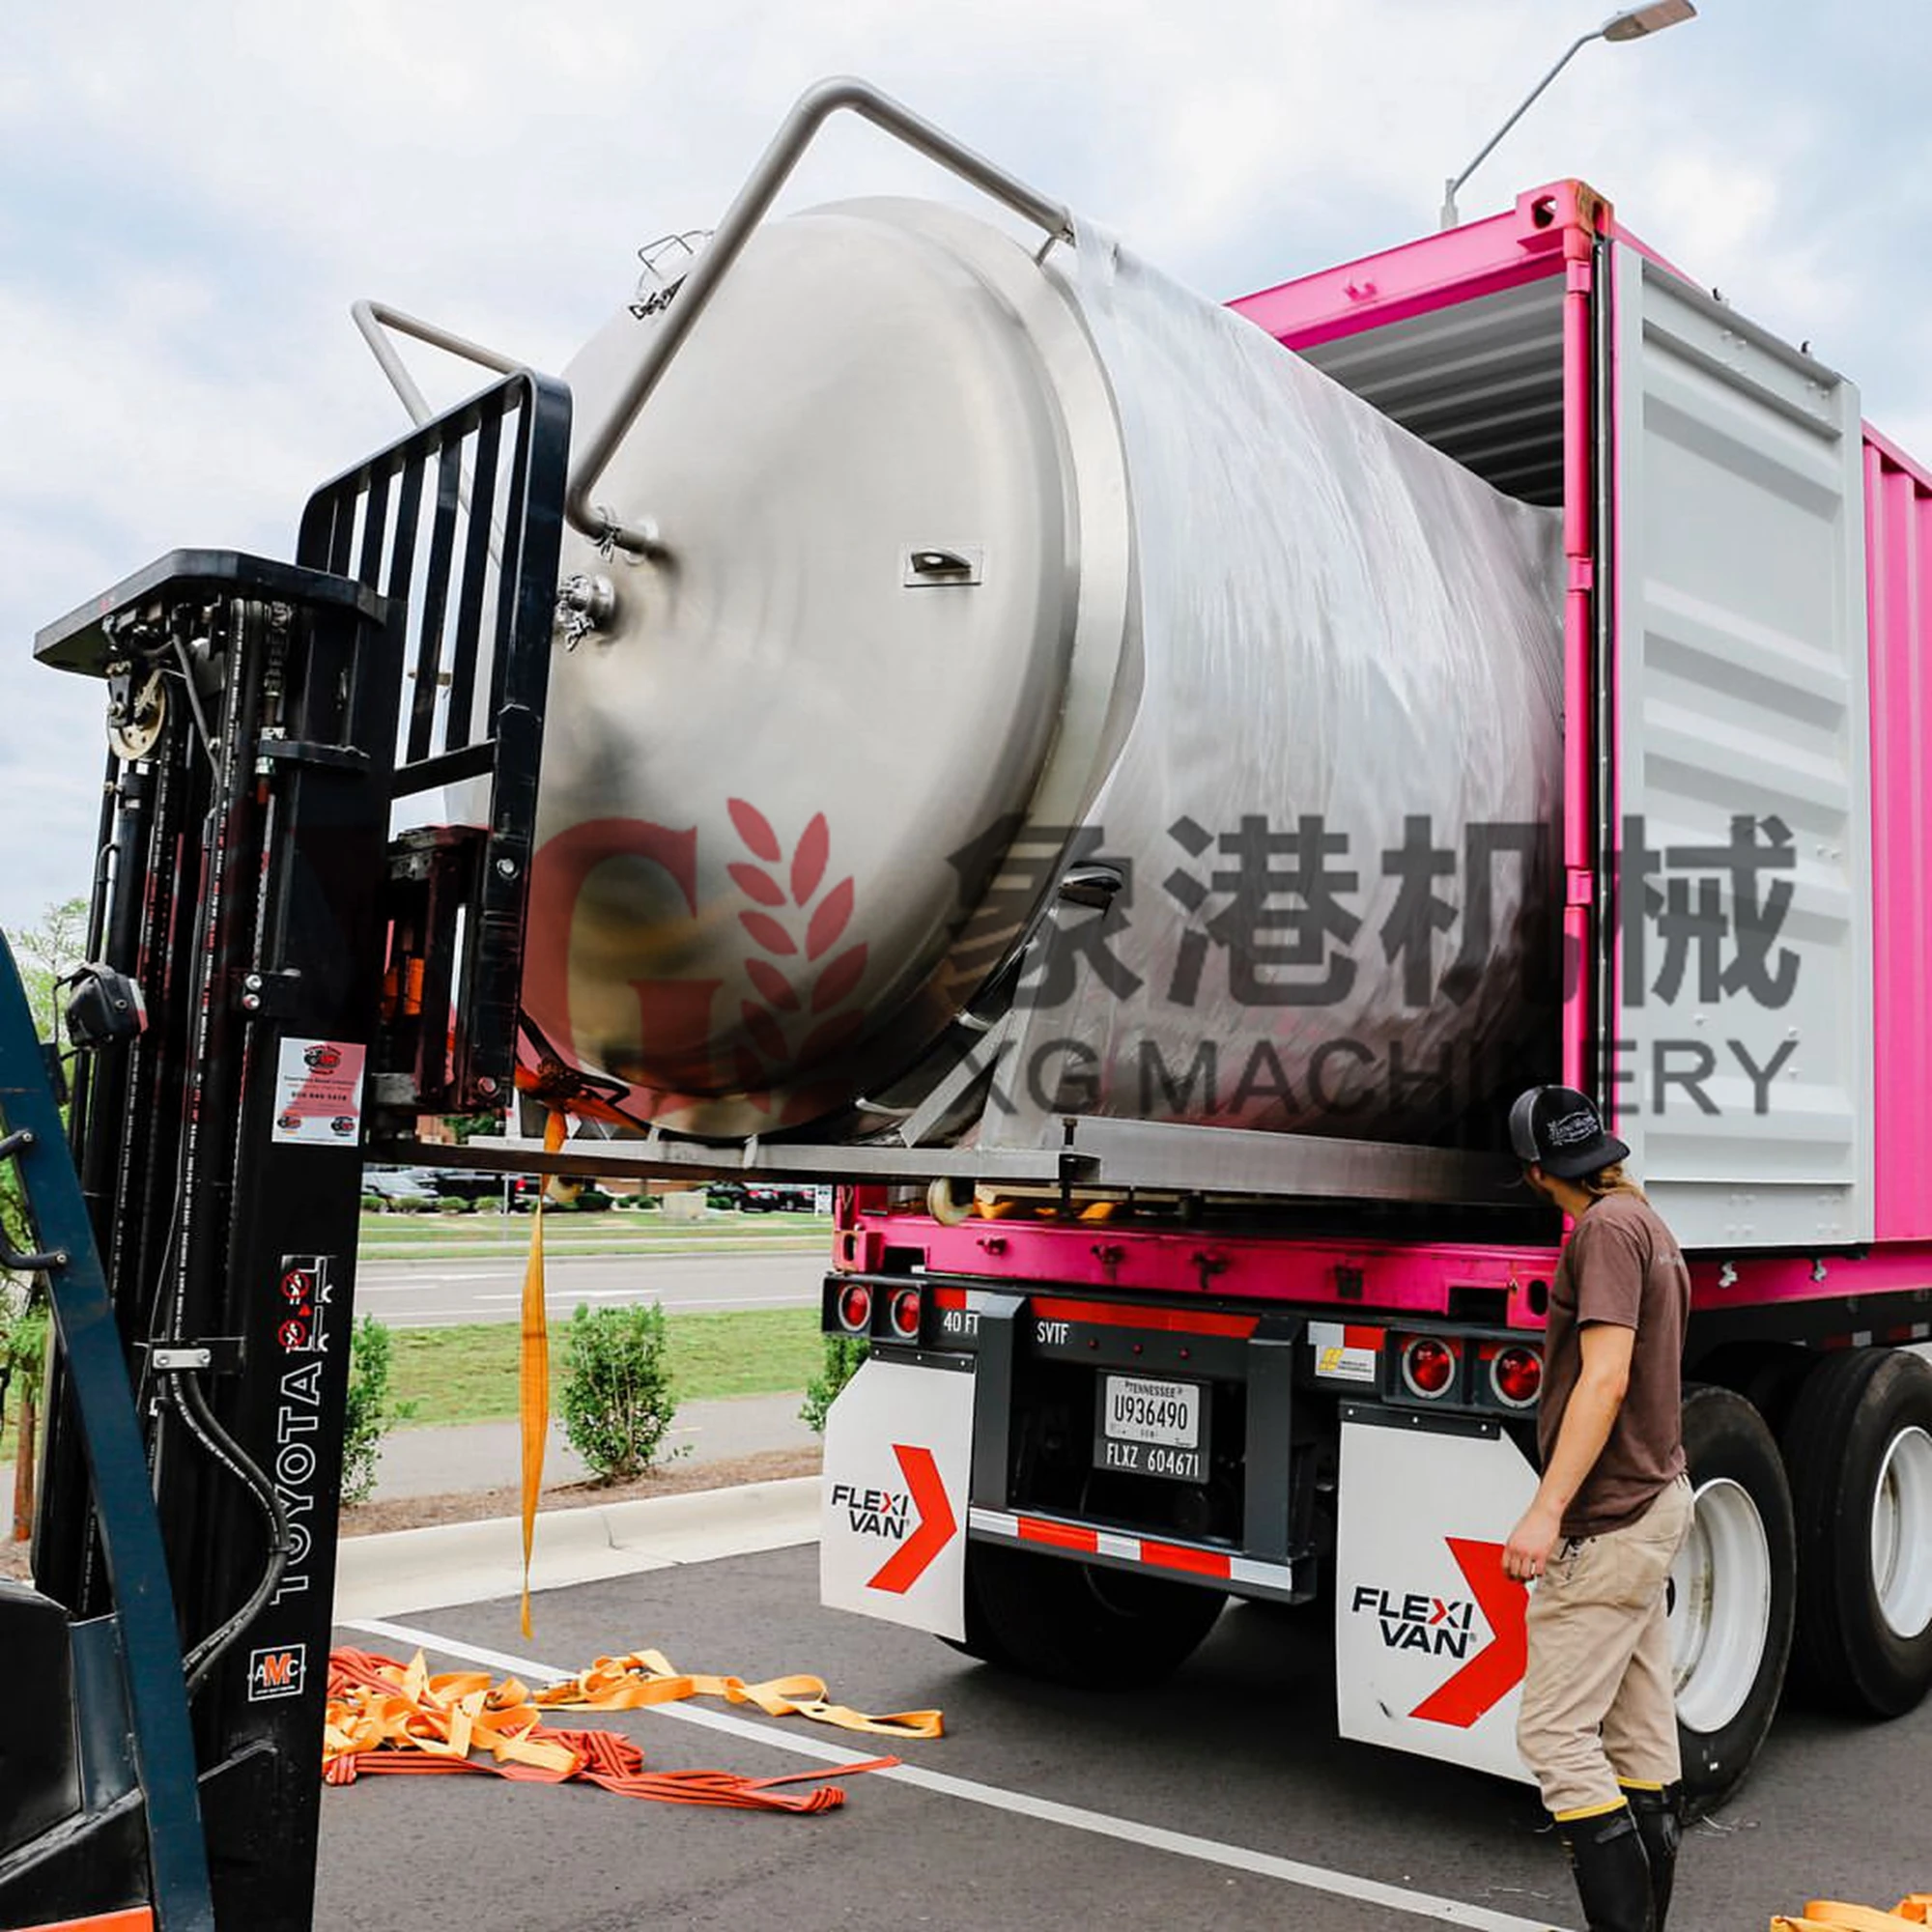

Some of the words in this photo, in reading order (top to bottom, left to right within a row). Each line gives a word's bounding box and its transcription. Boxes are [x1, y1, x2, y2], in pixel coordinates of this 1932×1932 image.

[943, 1310, 962, 1333] 40
[965, 1313, 980, 1335] FT
[1037, 1320, 1070, 1345] SVTF
[1128, 1381, 1177, 1399] TENNESSEE
[1114, 1393, 1188, 1431] U936490
[1106, 1442, 1139, 1469] FLXZ
[1147, 1449, 1199, 1479] 604671
[269, 1360, 323, 1606] TOYOTA
[831, 1484, 909, 1518] FLEXI
[848, 1509, 905, 1540] VAN
[1351, 1585, 1474, 1631] FLEXI
[1378, 1618, 1468, 1660] VAN
[254, 1653, 299, 1688] AMC
